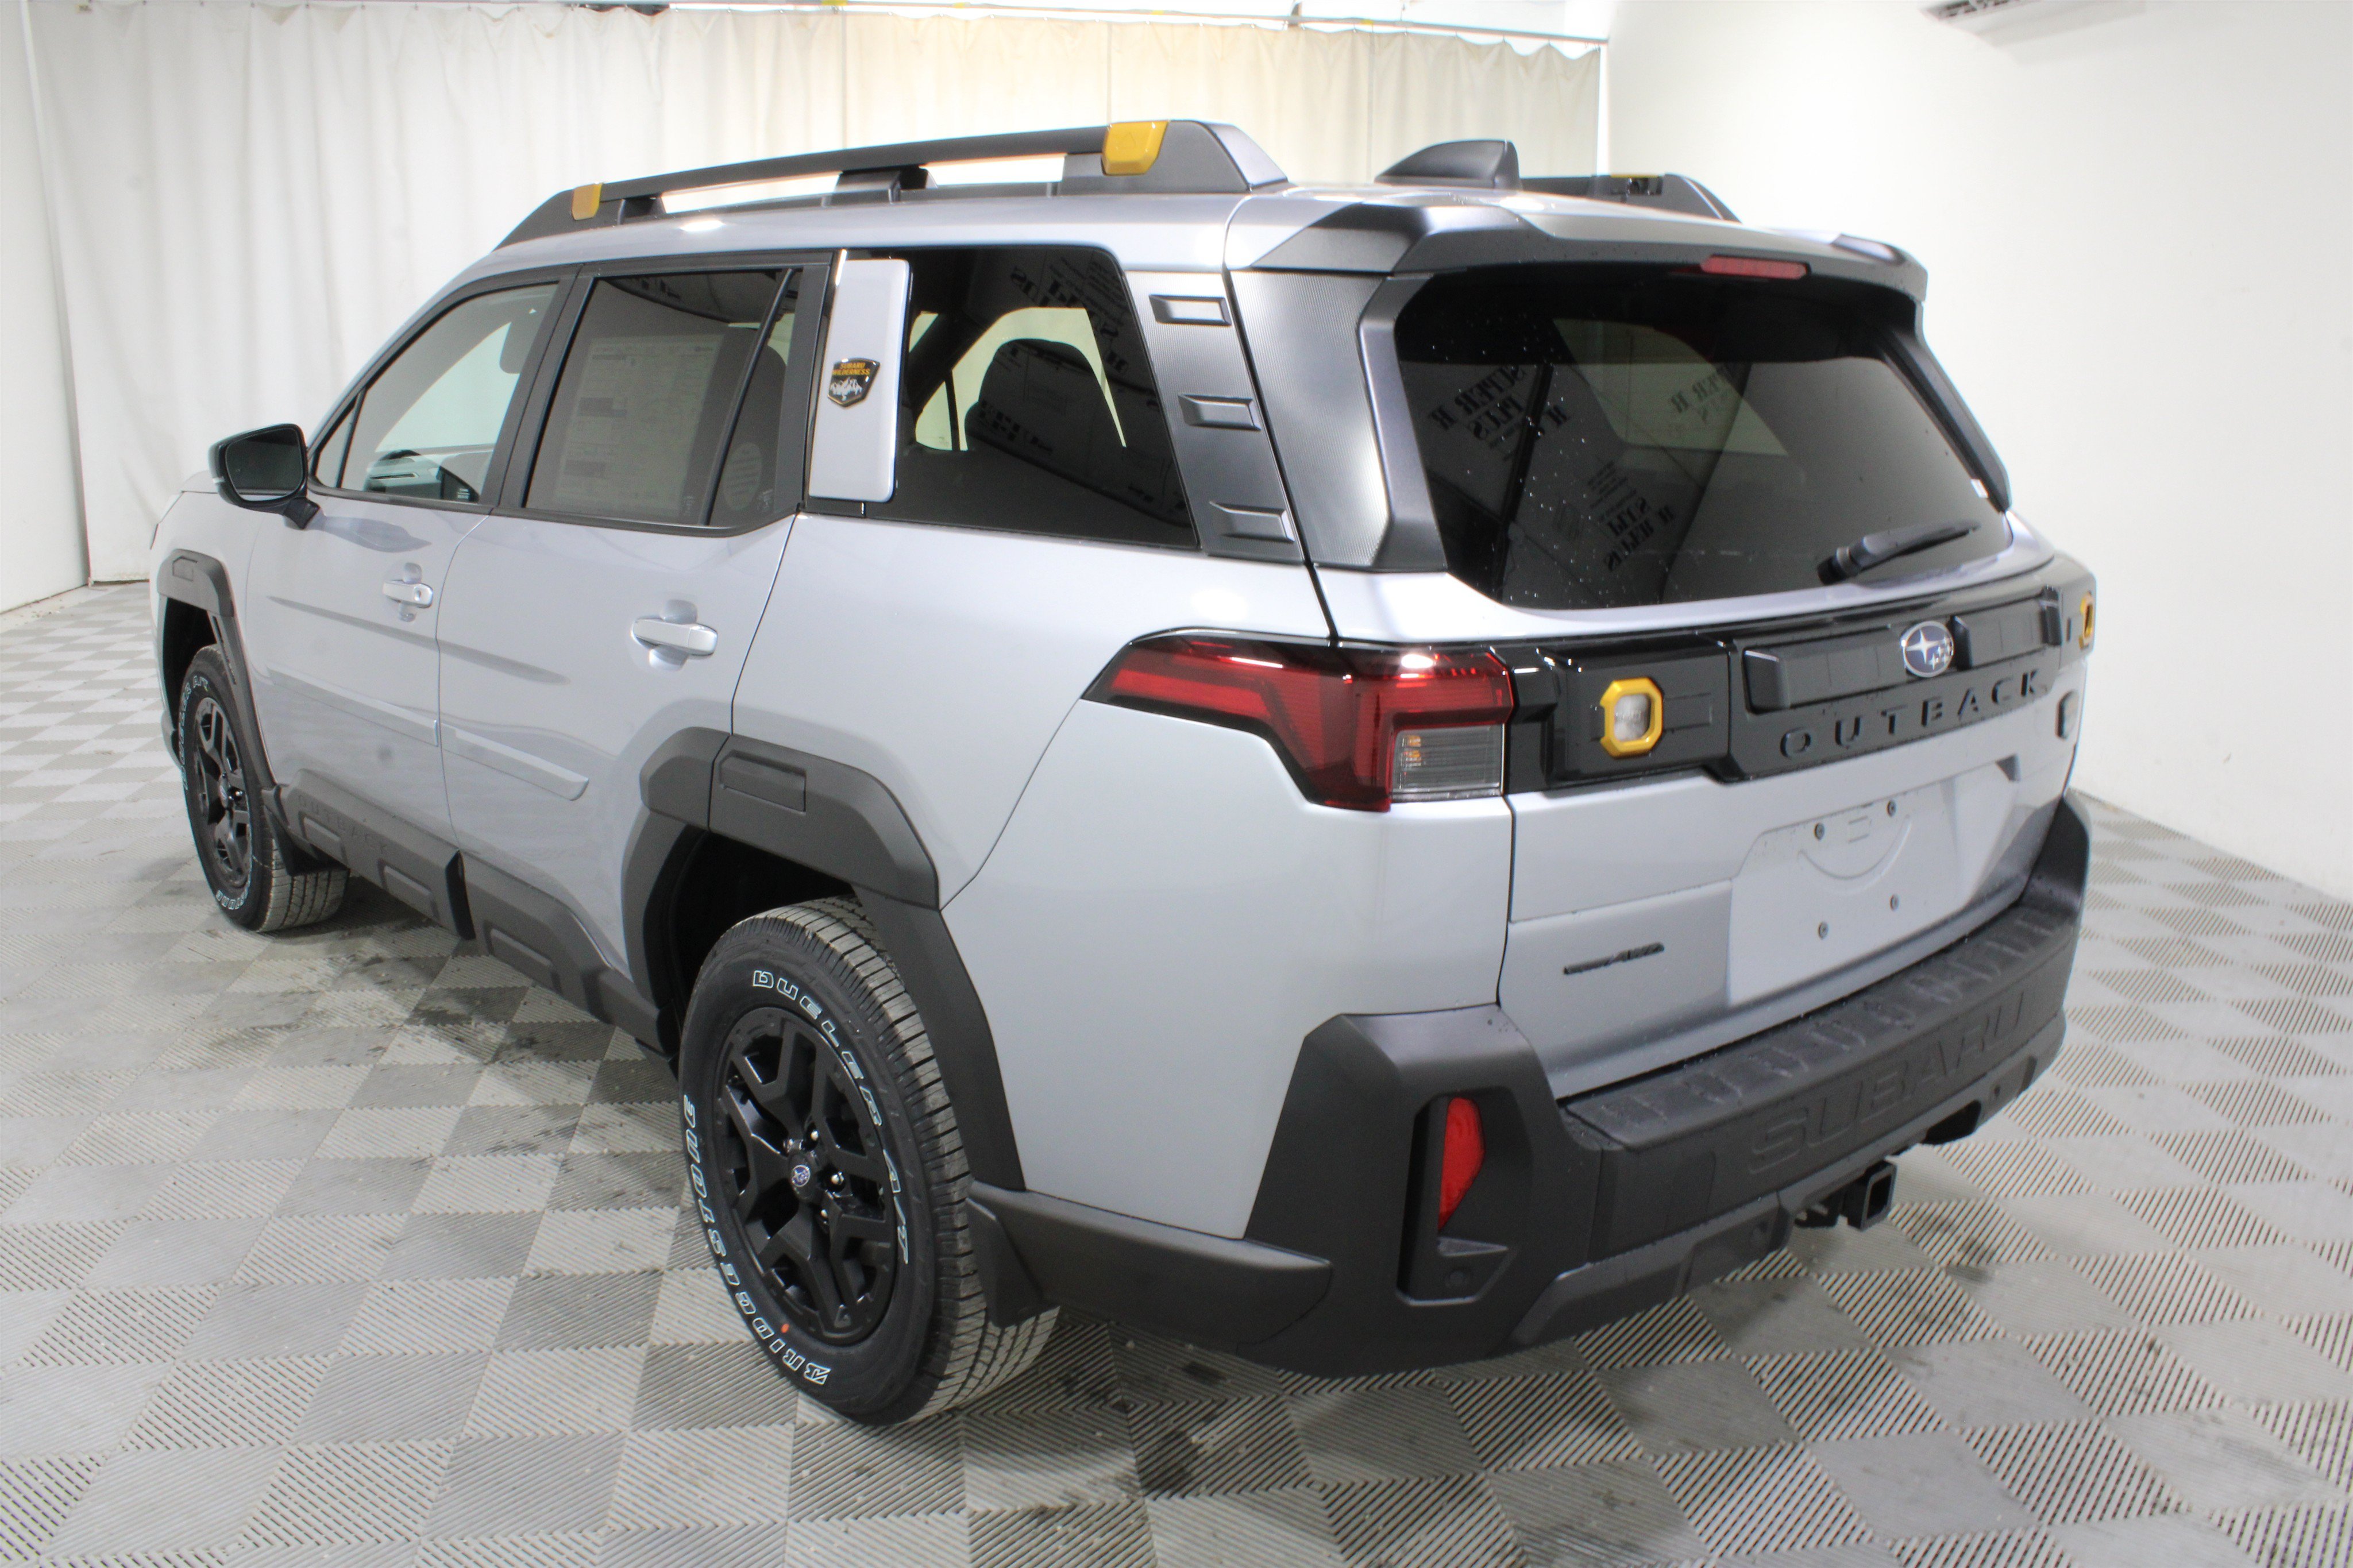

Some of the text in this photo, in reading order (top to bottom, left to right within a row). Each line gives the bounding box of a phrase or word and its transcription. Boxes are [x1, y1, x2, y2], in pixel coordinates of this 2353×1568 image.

[1780, 667, 2039, 760] OUTBACK
[752, 969, 909, 1265] DUELER A/T
[1749, 989, 2026, 1176] SUBARU
[683, 1094, 832, 1386] BRIDGESTONE
